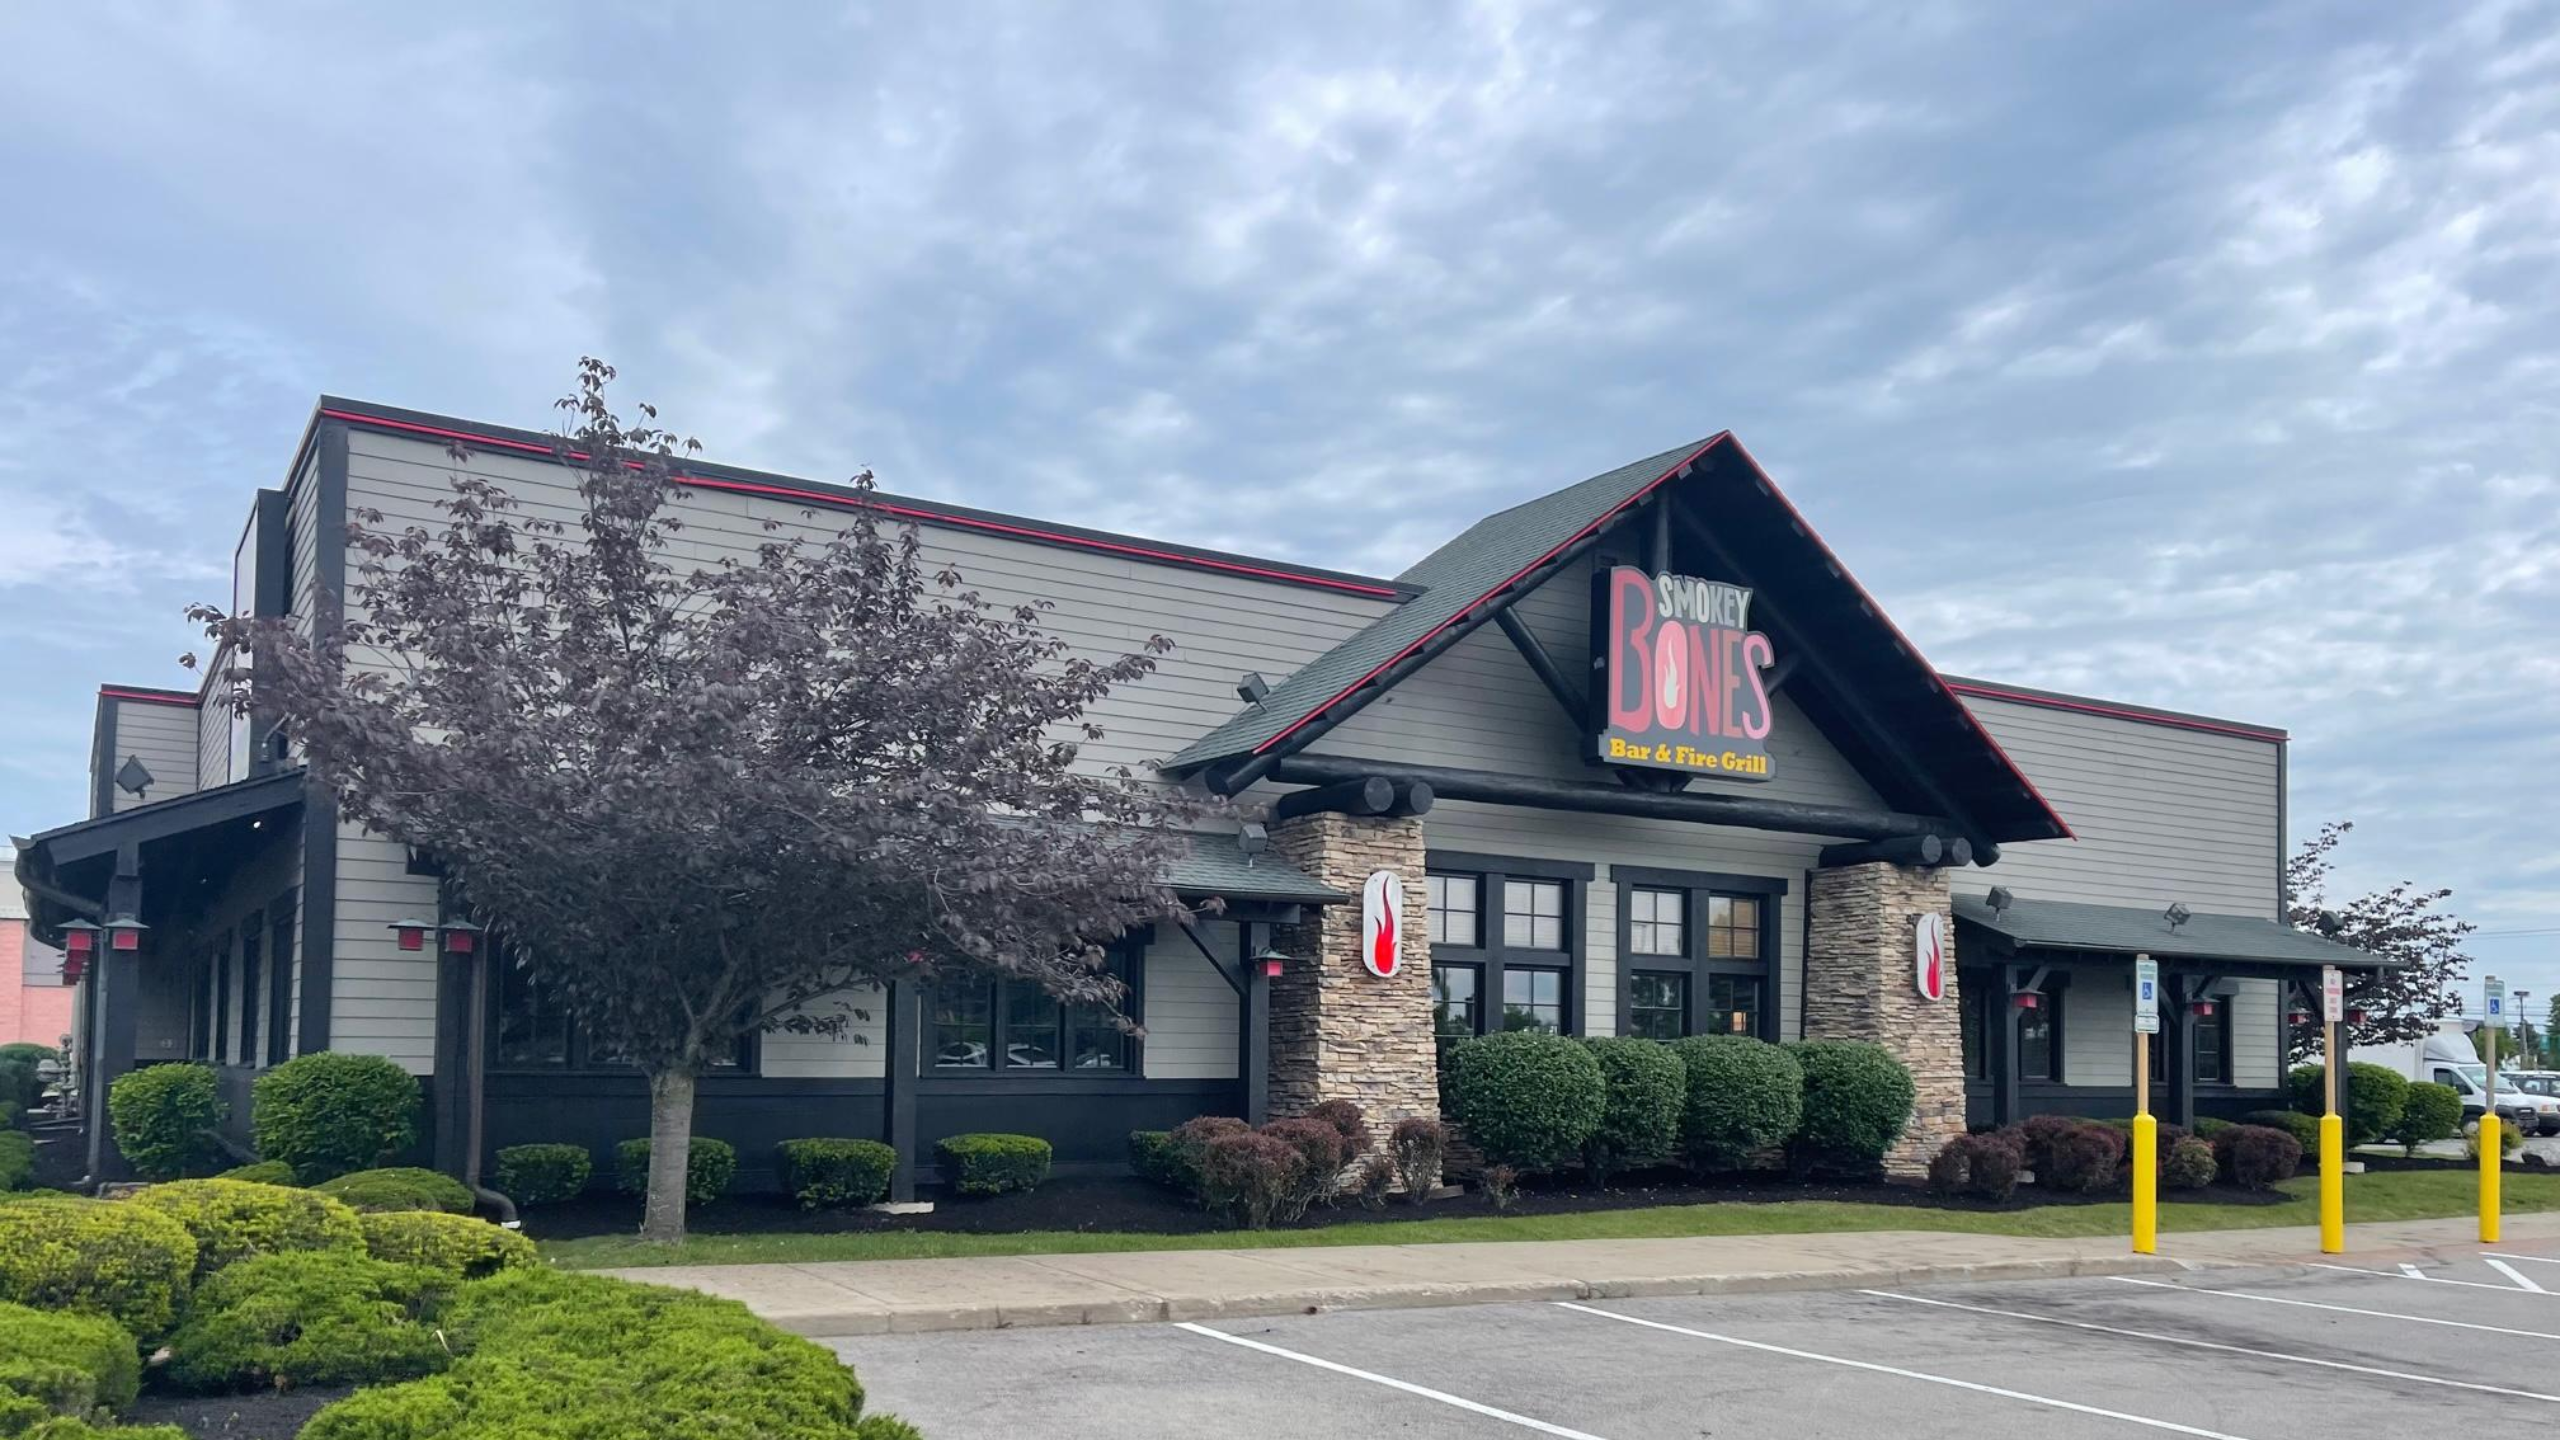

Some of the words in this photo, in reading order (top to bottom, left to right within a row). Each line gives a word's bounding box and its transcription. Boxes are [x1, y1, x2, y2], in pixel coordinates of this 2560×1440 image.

[1658, 574, 1750, 628] SMOKEY
[1609, 567, 1772, 740] BONES
[1610, 738, 1651, 760] Bar
[1655, 743, 1671, 763] &
[1675, 746, 1718, 768] Fire
[1721, 751, 1767, 774] Grill
